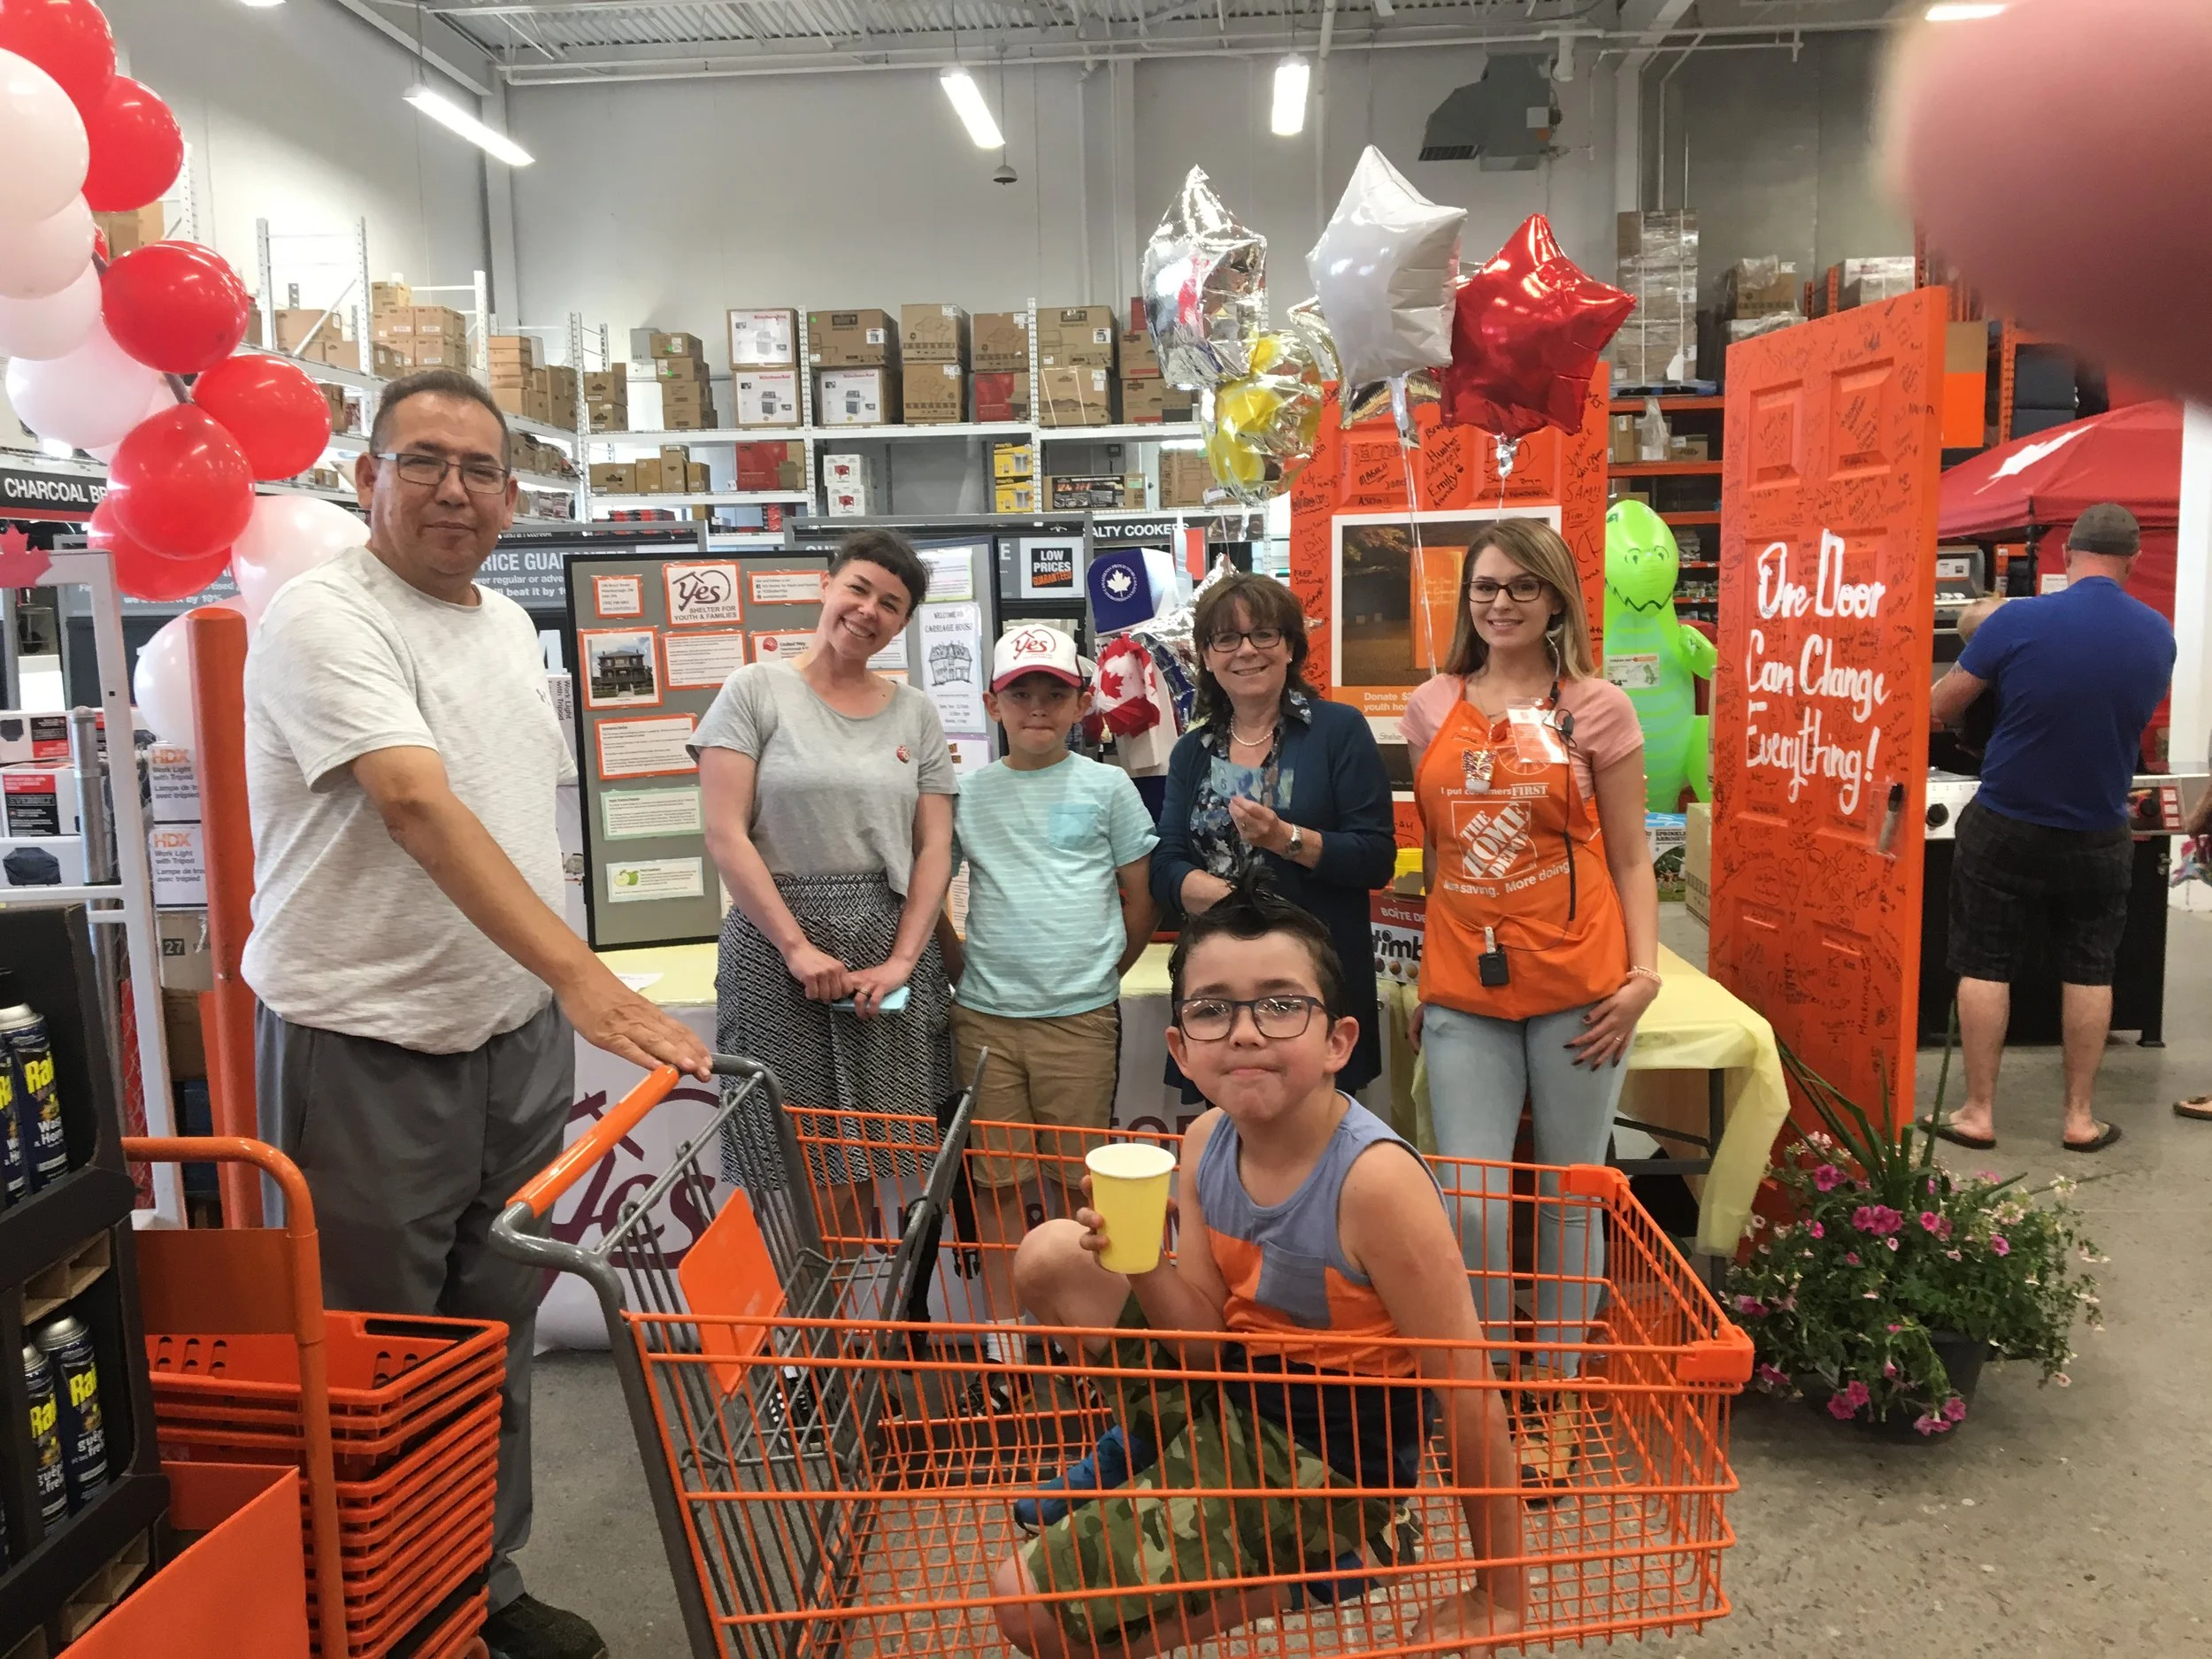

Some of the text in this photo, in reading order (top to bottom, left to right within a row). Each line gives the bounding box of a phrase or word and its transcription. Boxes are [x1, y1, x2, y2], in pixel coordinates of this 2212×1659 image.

[4, 477, 88, 503] CHARCOAL
[480, 552, 519, 572] RICE
[1041, 549, 1064, 561] LOW
[1033, 561, 1071, 573] PRICES
[1757, 527, 1886, 619] One Door
[492, 574, 526, 586] regular
[541, 574, 565, 584] adve
[1032, 570, 1073, 587] GUARANTEED
[506, 587, 530, 596] beat
[542, 587, 555, 597] by
[1746, 629, 1892, 723] Can Change
[1363, 692, 1398, 701] Donate
[1363, 703, 1389, 712] youth
[152, 749, 190, 764] HDX
[1746, 699, 1880, 815] Everything!
[1440, 786, 1445, 795] I
[1447, 787, 1463, 796] put
[1511, 785, 1548, 796] FIRST
[1460, 810, 1492, 842] THE
[154, 833, 192, 848] HDX
[1463, 800, 1530, 879] HOME
[1505, 875, 1537, 894] More
[1380, 906, 1412, 921] BOÎTE
[164, 939, 184, 955] 27
